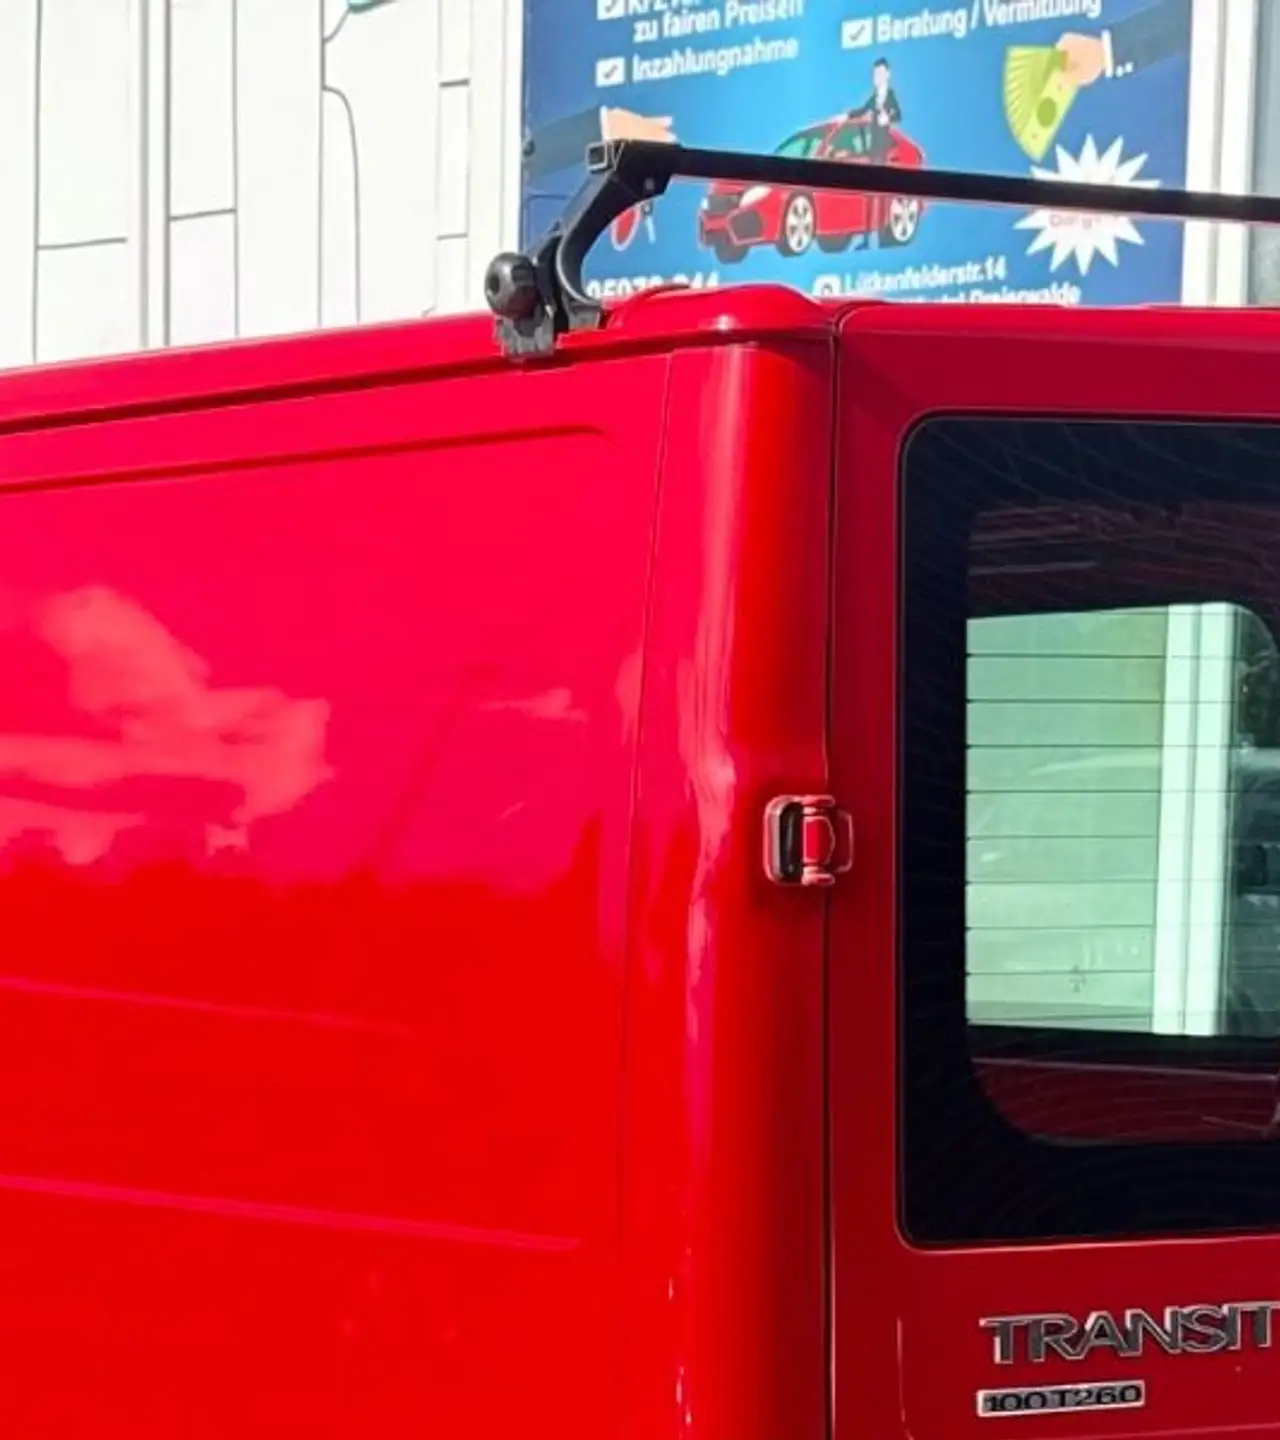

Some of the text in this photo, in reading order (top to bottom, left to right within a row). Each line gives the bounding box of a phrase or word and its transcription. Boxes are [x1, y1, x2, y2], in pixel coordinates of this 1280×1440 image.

[633, 0, 804, 43] zu fairen Preisen
[876, 0, 1101, 42] Beratung / Vermittlung
[632, 36, 799, 83] Inzahlungnahme
[983, 1384, 1143, 1412] 100T260
